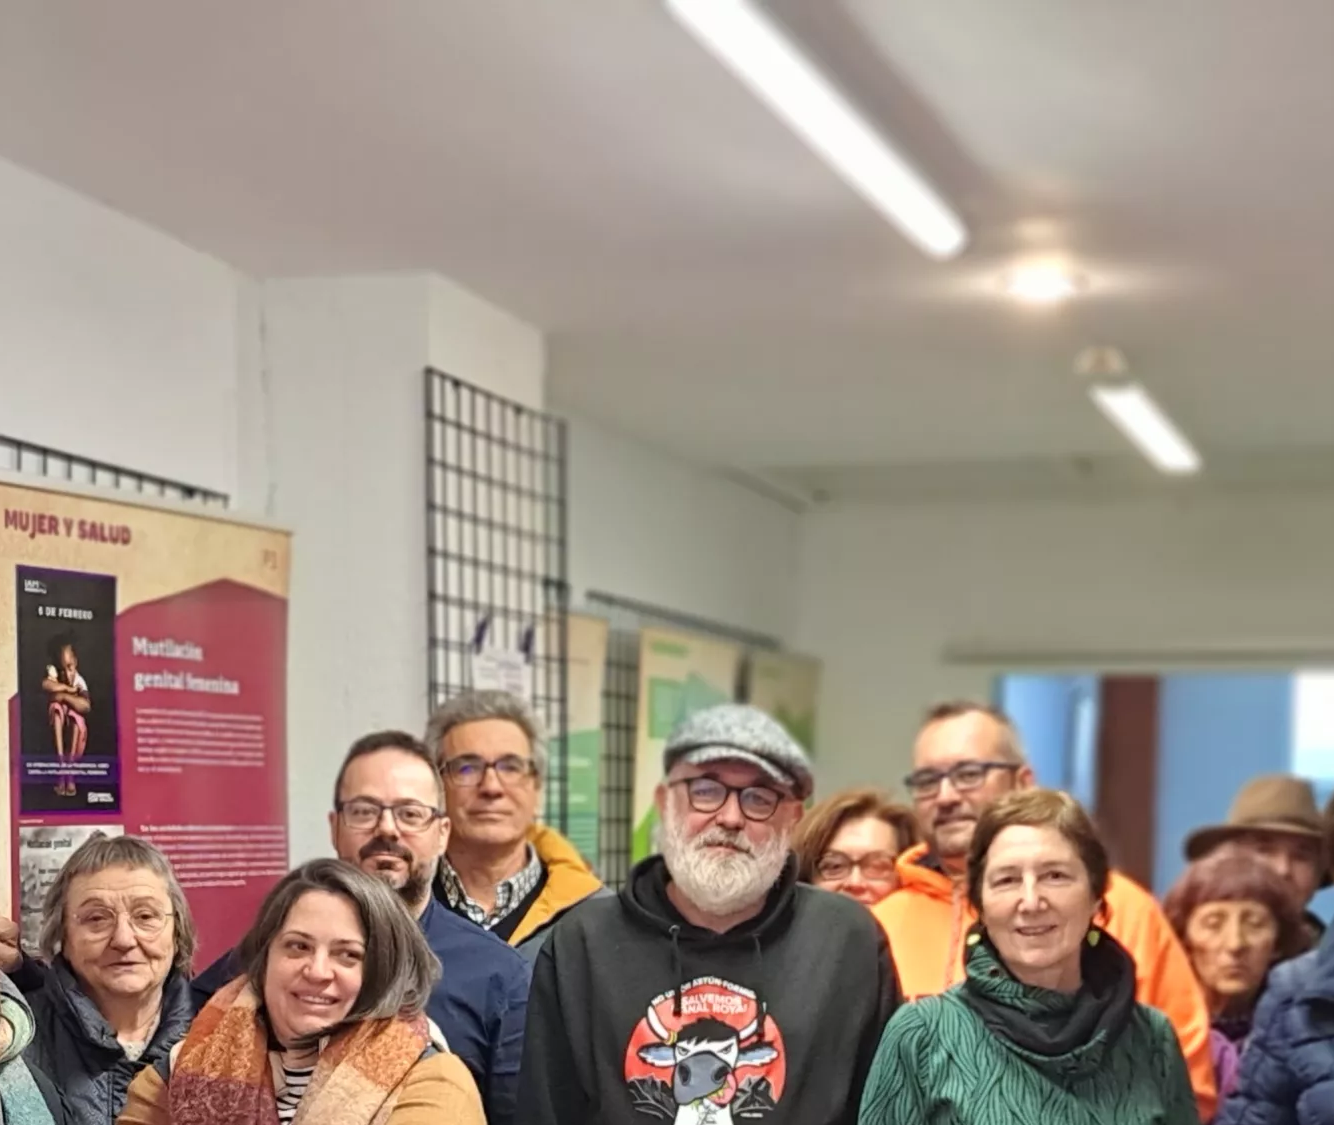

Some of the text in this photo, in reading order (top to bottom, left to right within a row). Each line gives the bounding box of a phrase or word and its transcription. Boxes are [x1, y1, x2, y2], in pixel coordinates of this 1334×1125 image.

[4, 509, 132, 545] MUJER Y SALUD
[45, 606, 56, 617] DE
[58, 607, 93, 620] FEBRERO
[134, 671, 185, 692] genital
